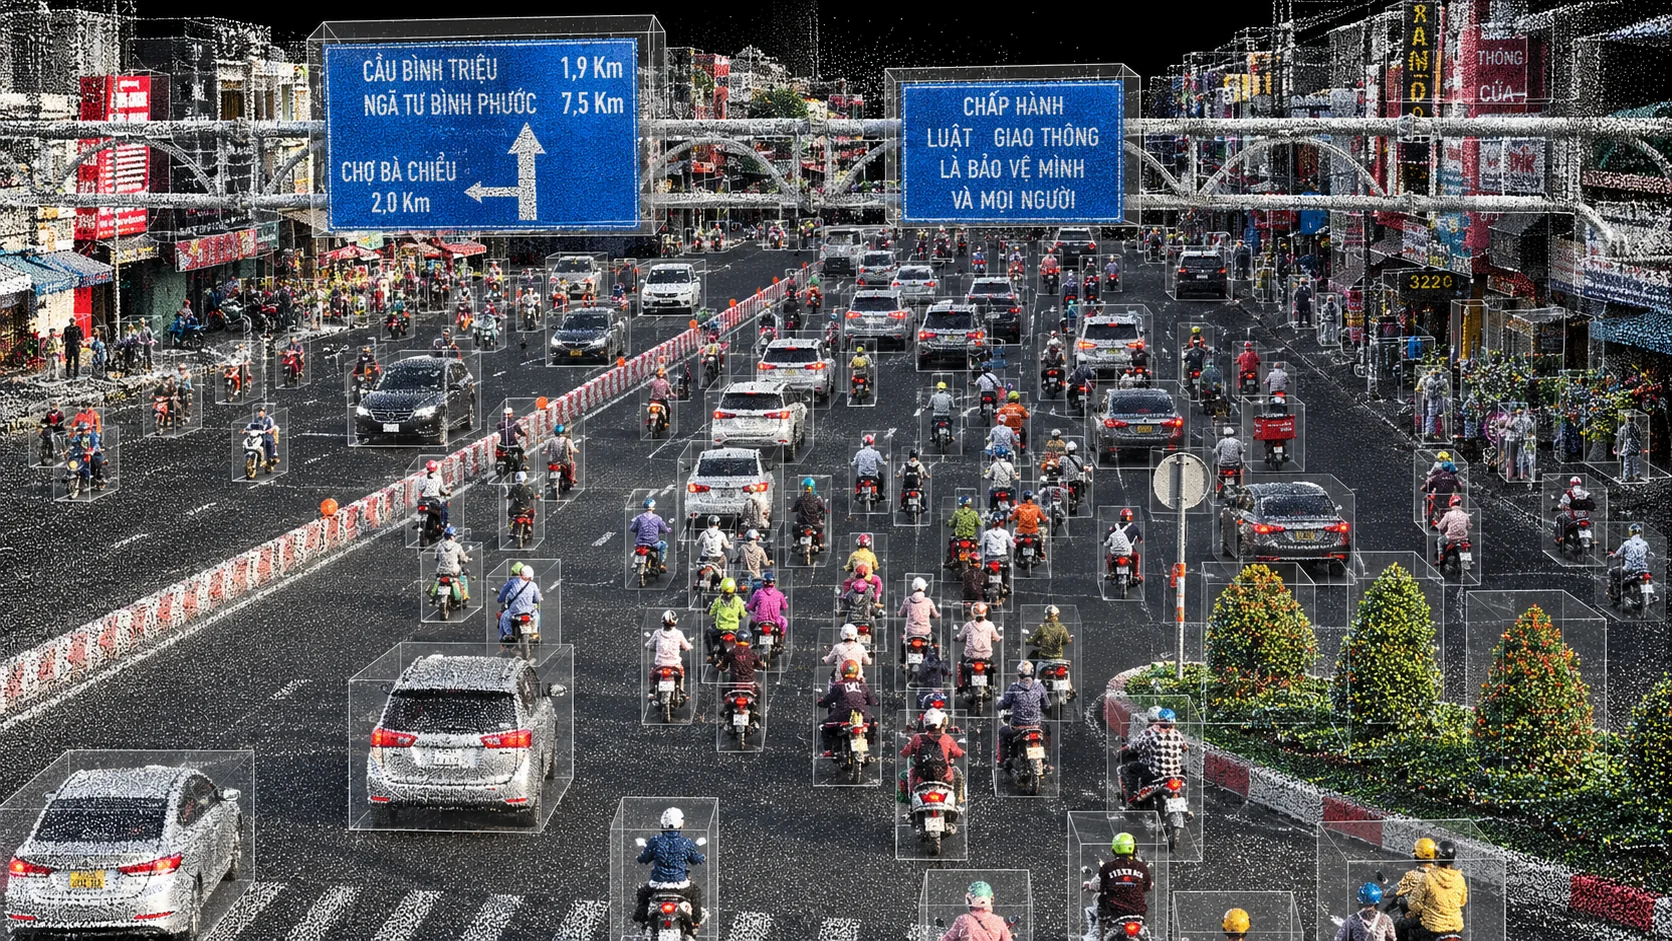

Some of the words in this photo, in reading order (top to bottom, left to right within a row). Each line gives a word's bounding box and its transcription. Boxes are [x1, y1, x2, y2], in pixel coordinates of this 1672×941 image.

[363, 52, 397, 83] CẦU
[402, 54, 443, 82] BÌNH
[448, 53, 498, 84] TRIỆU
[560, 56, 587, 81] 1,9
[593, 56, 623, 79] Km
[364, 90, 399, 116] NGÃ
[403, 91, 426, 116] TƯ
[431, 88, 472, 116] BÌNH
[477, 87, 537, 116] PHƯỚC
[561, 91, 589, 117] 7,5
[594, 91, 624, 115] Km
[963, 89, 1010, 117] CHẤP
[1016, 91, 1063, 116] HÀNH
[927, 122, 973, 152] LUẬT
[994, 127, 1034, 147] GIAO
[1040, 122, 1099, 147] THÔNG
[341, 160, 376, 186] CHỢ
[380, 155, 403, 182] BÀ
[407, 151, 457, 182] CHIỂU
[940, 154, 962, 179] LÀ
[968, 152, 1002, 179] BẢO
[1009, 154, 1032, 182] VỆ
[1038, 153, 1085, 179] MÌNH
[371, 191, 398, 215] 2,0
[402, 191, 430, 213] Km
[951, 185, 974, 210] VÀ
[980, 190, 1013, 213] MỌI
[1021, 185, 1076, 210] NGƯỜI
[1409, 275, 1453, 289] 3220
